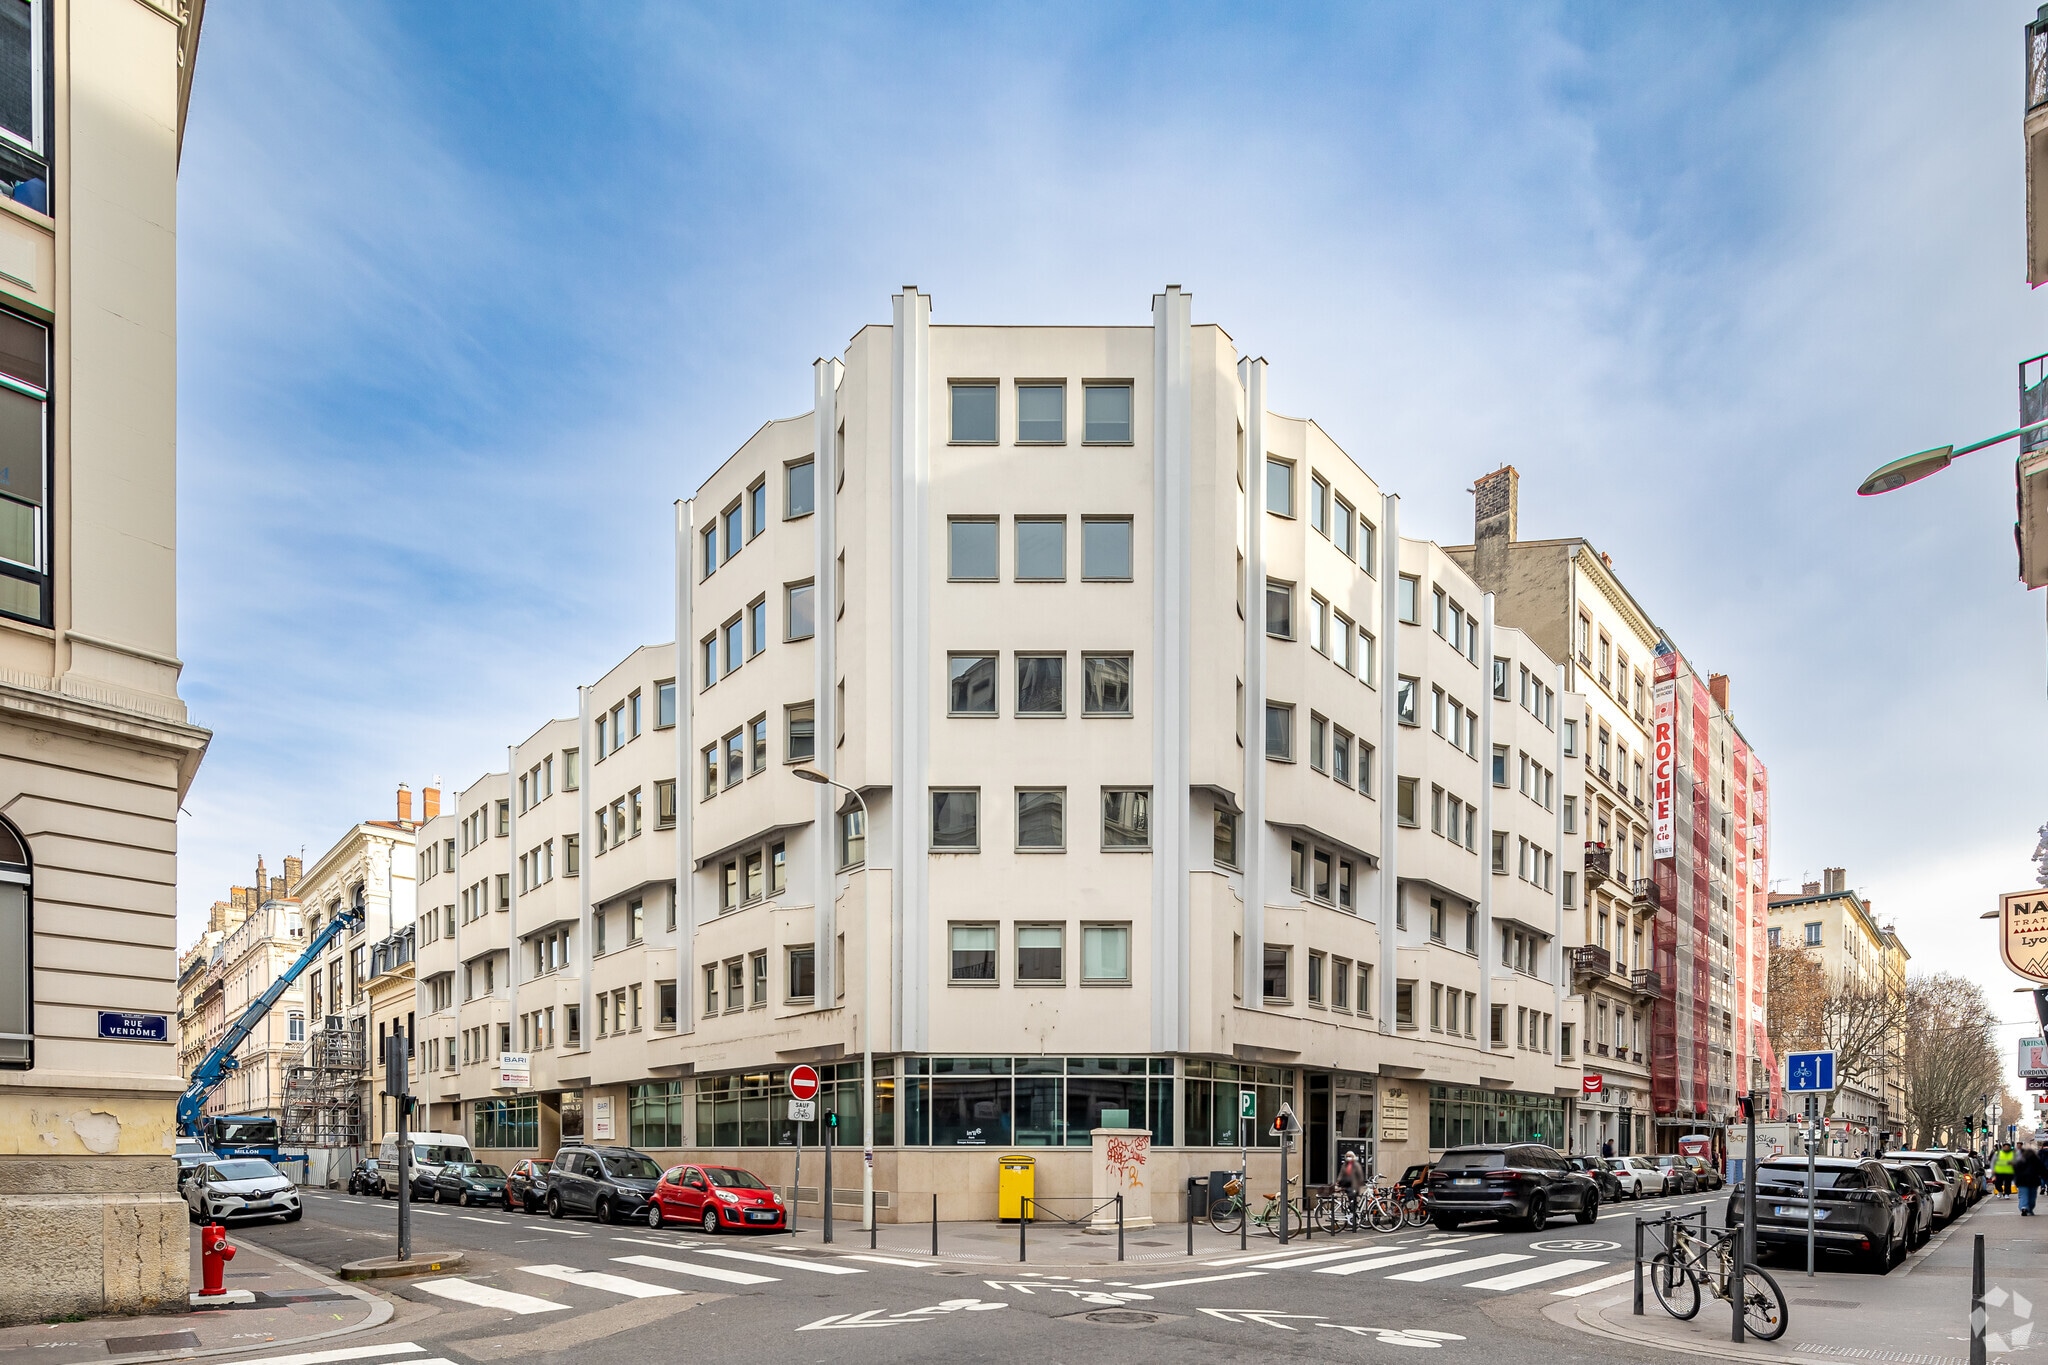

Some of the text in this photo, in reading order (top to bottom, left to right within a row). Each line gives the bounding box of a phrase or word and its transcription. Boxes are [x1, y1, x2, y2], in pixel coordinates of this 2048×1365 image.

[1656, 722, 1671, 820] ROCHE
[1659, 824, 1667, 832] et
[1657, 832, 1669, 841] Cie
[2021, 936, 2048, 947] Lyo
[110, 1027, 156, 1037] VENDÔME
[1243, 1095, 1250, 1112] P
